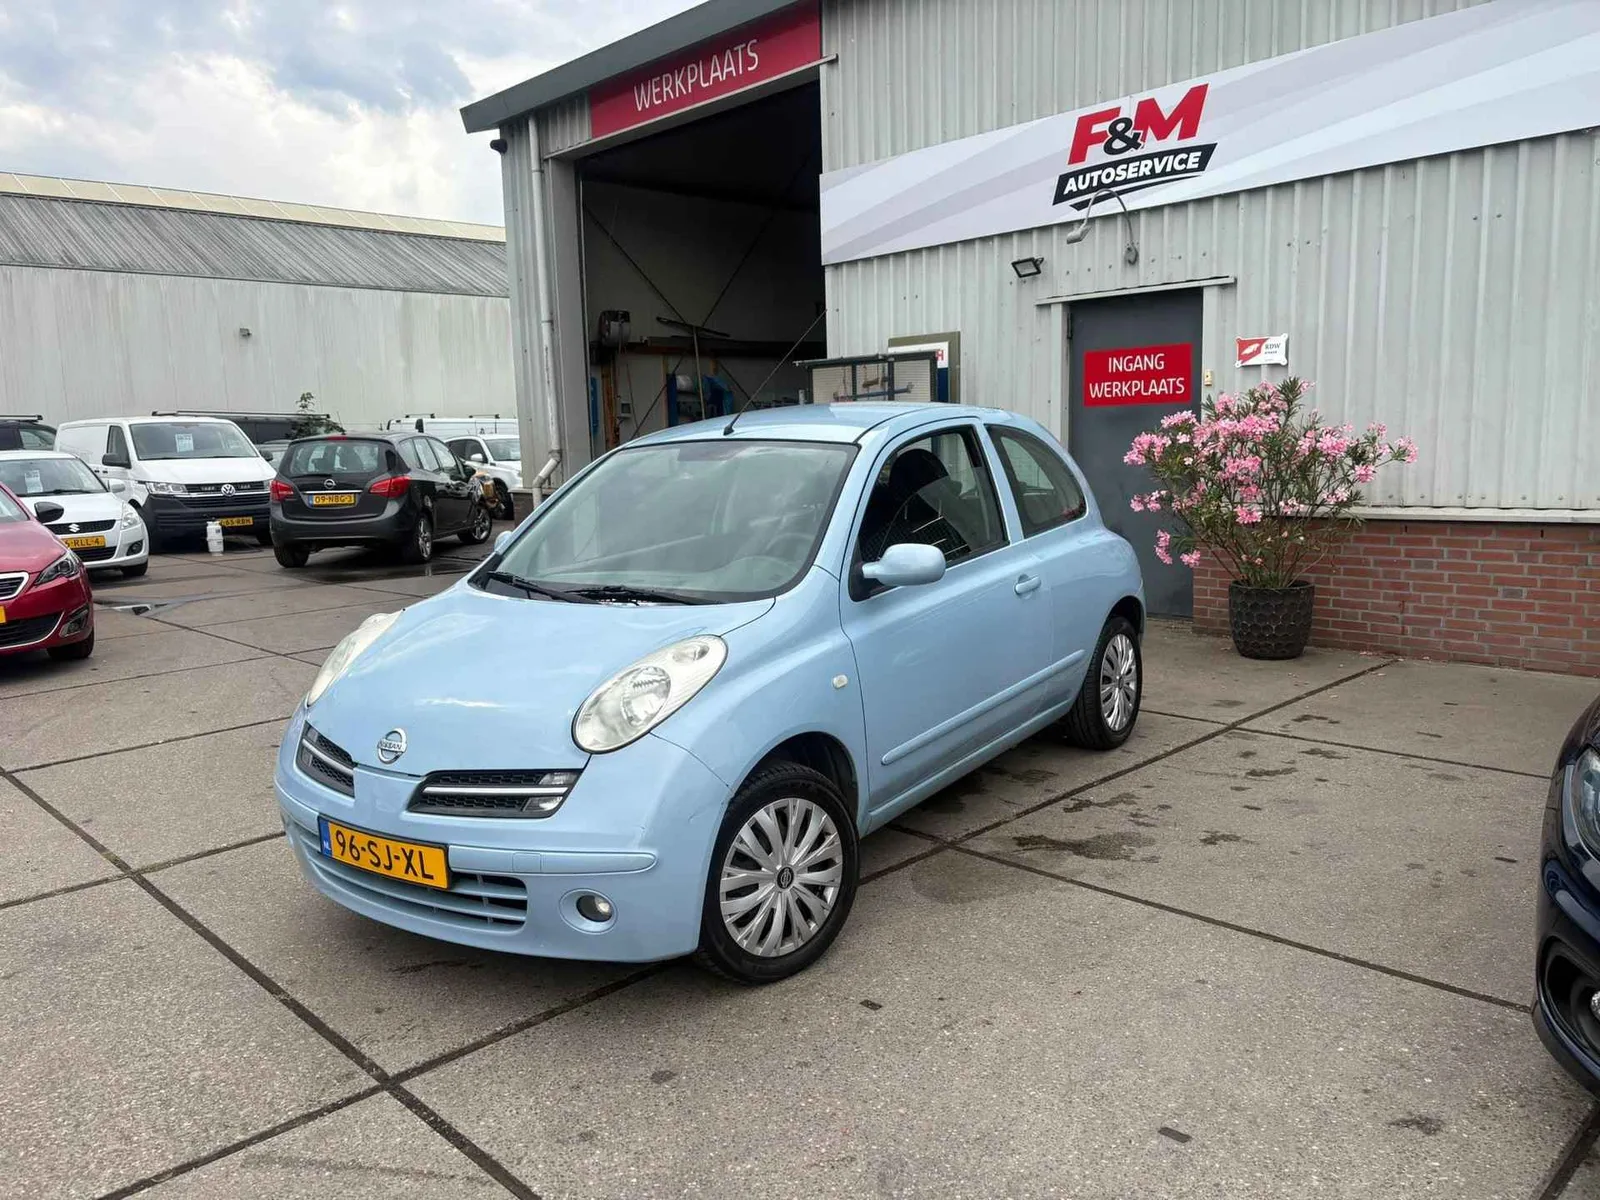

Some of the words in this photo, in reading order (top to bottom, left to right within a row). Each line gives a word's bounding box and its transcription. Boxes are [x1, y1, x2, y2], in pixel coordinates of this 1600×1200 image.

[634, 39, 759, 112] WERKPLAATS
[1067, 83, 1209, 165] F&M
[1063, 151, 1202, 195] AUTOSERVICE
[1108, 353, 1165, 374] INGANG
[1089, 377, 1185, 399] WERKPLAATS
[379, 740, 402, 750] NISSAN
[335, 829, 434, 880] 96-SJ-XL
